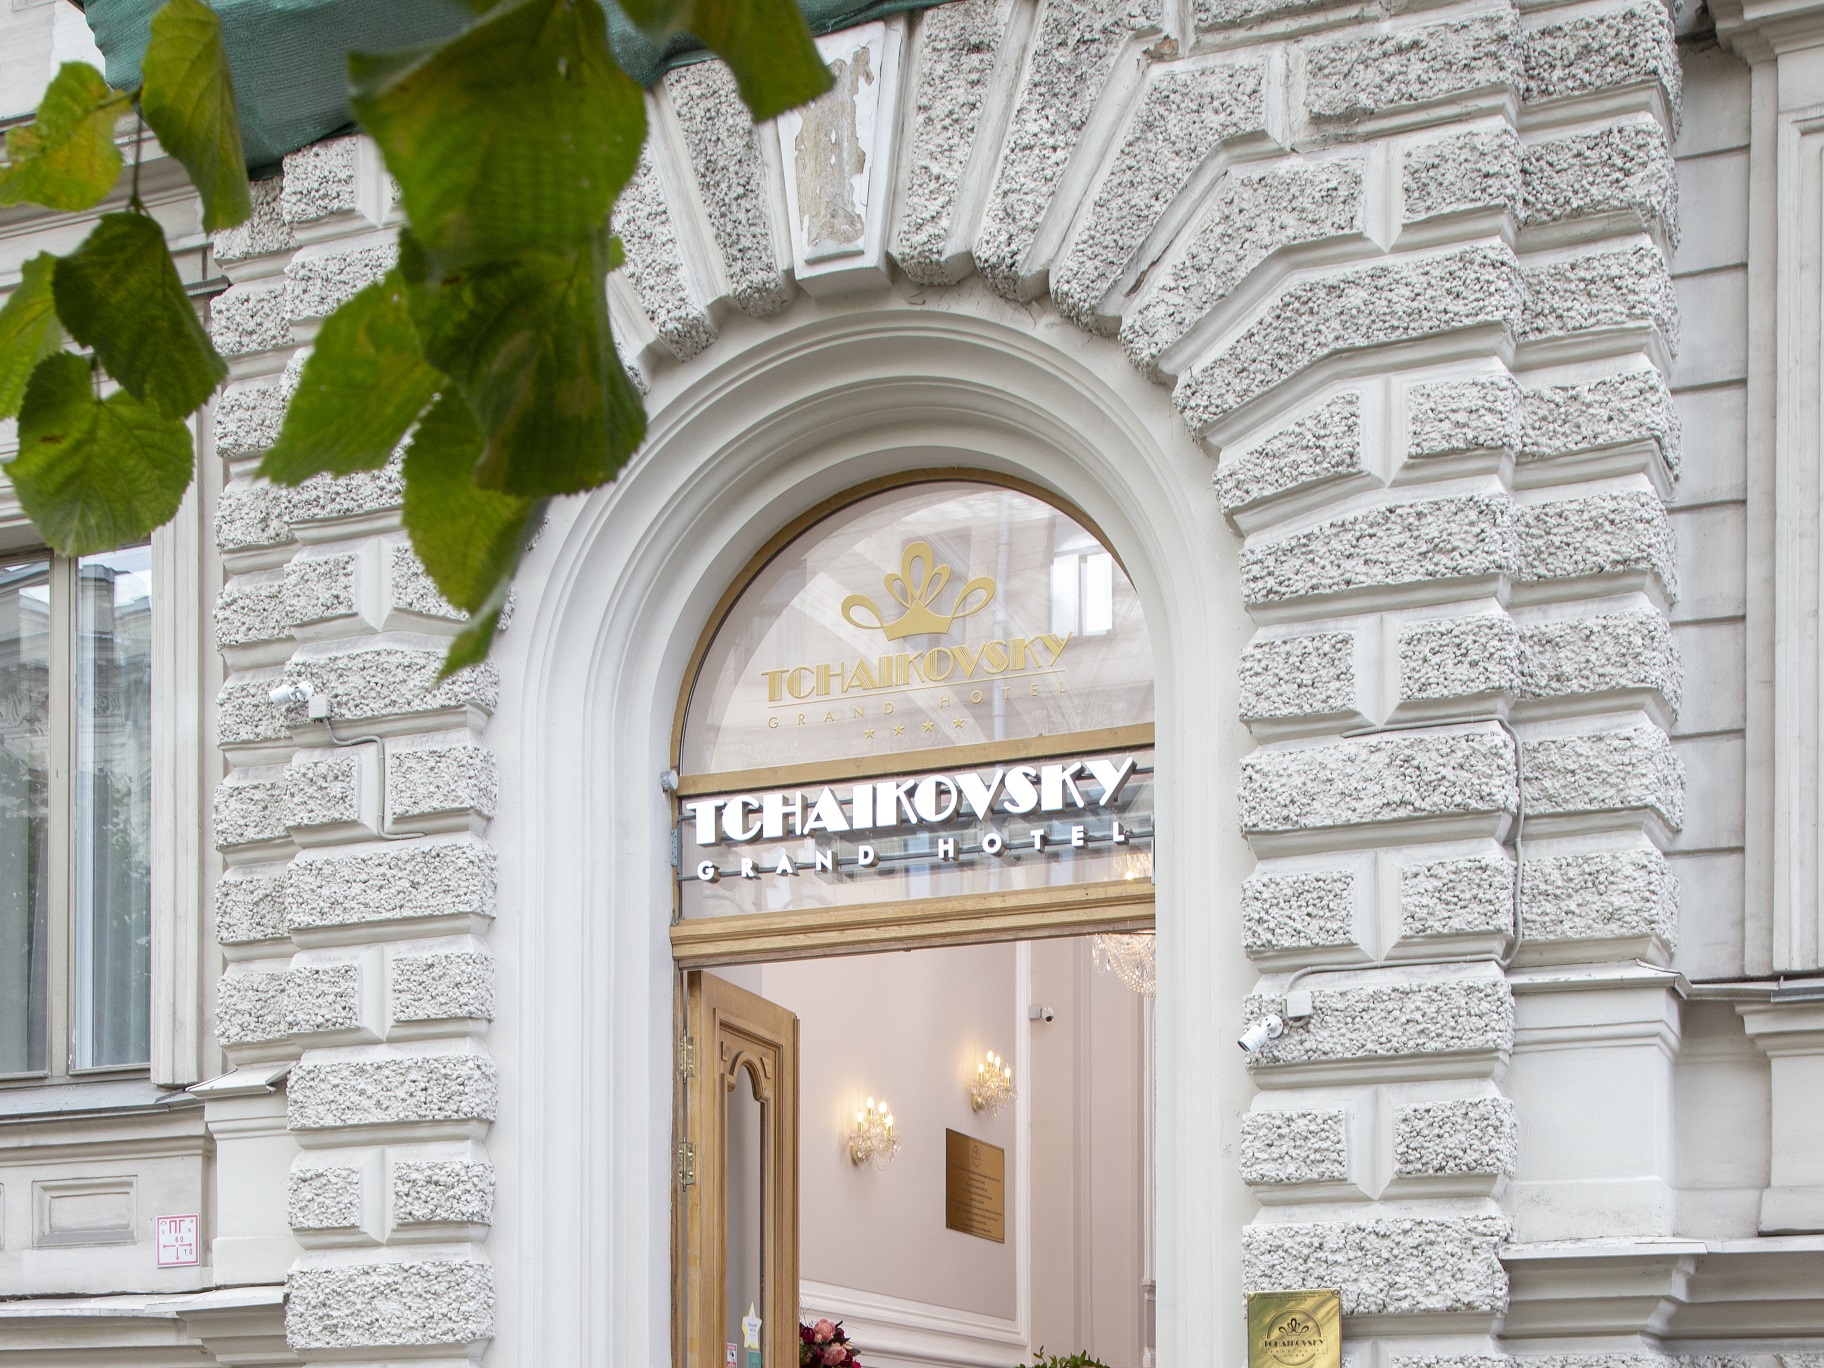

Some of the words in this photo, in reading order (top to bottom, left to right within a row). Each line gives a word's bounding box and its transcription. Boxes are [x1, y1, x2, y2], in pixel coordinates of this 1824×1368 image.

[760, 630, 1074, 702] TCHAIKOVSKY
[768, 702, 895, 729] GRAND
[940, 680, 1066, 709] HOTEL
[686, 757, 1138, 846] TCHAIKOVSKY
[696, 844, 881, 882] GRAND
[938, 823, 1130, 861] HOTEL
[169, 1219, 185, 1234] ПГ
